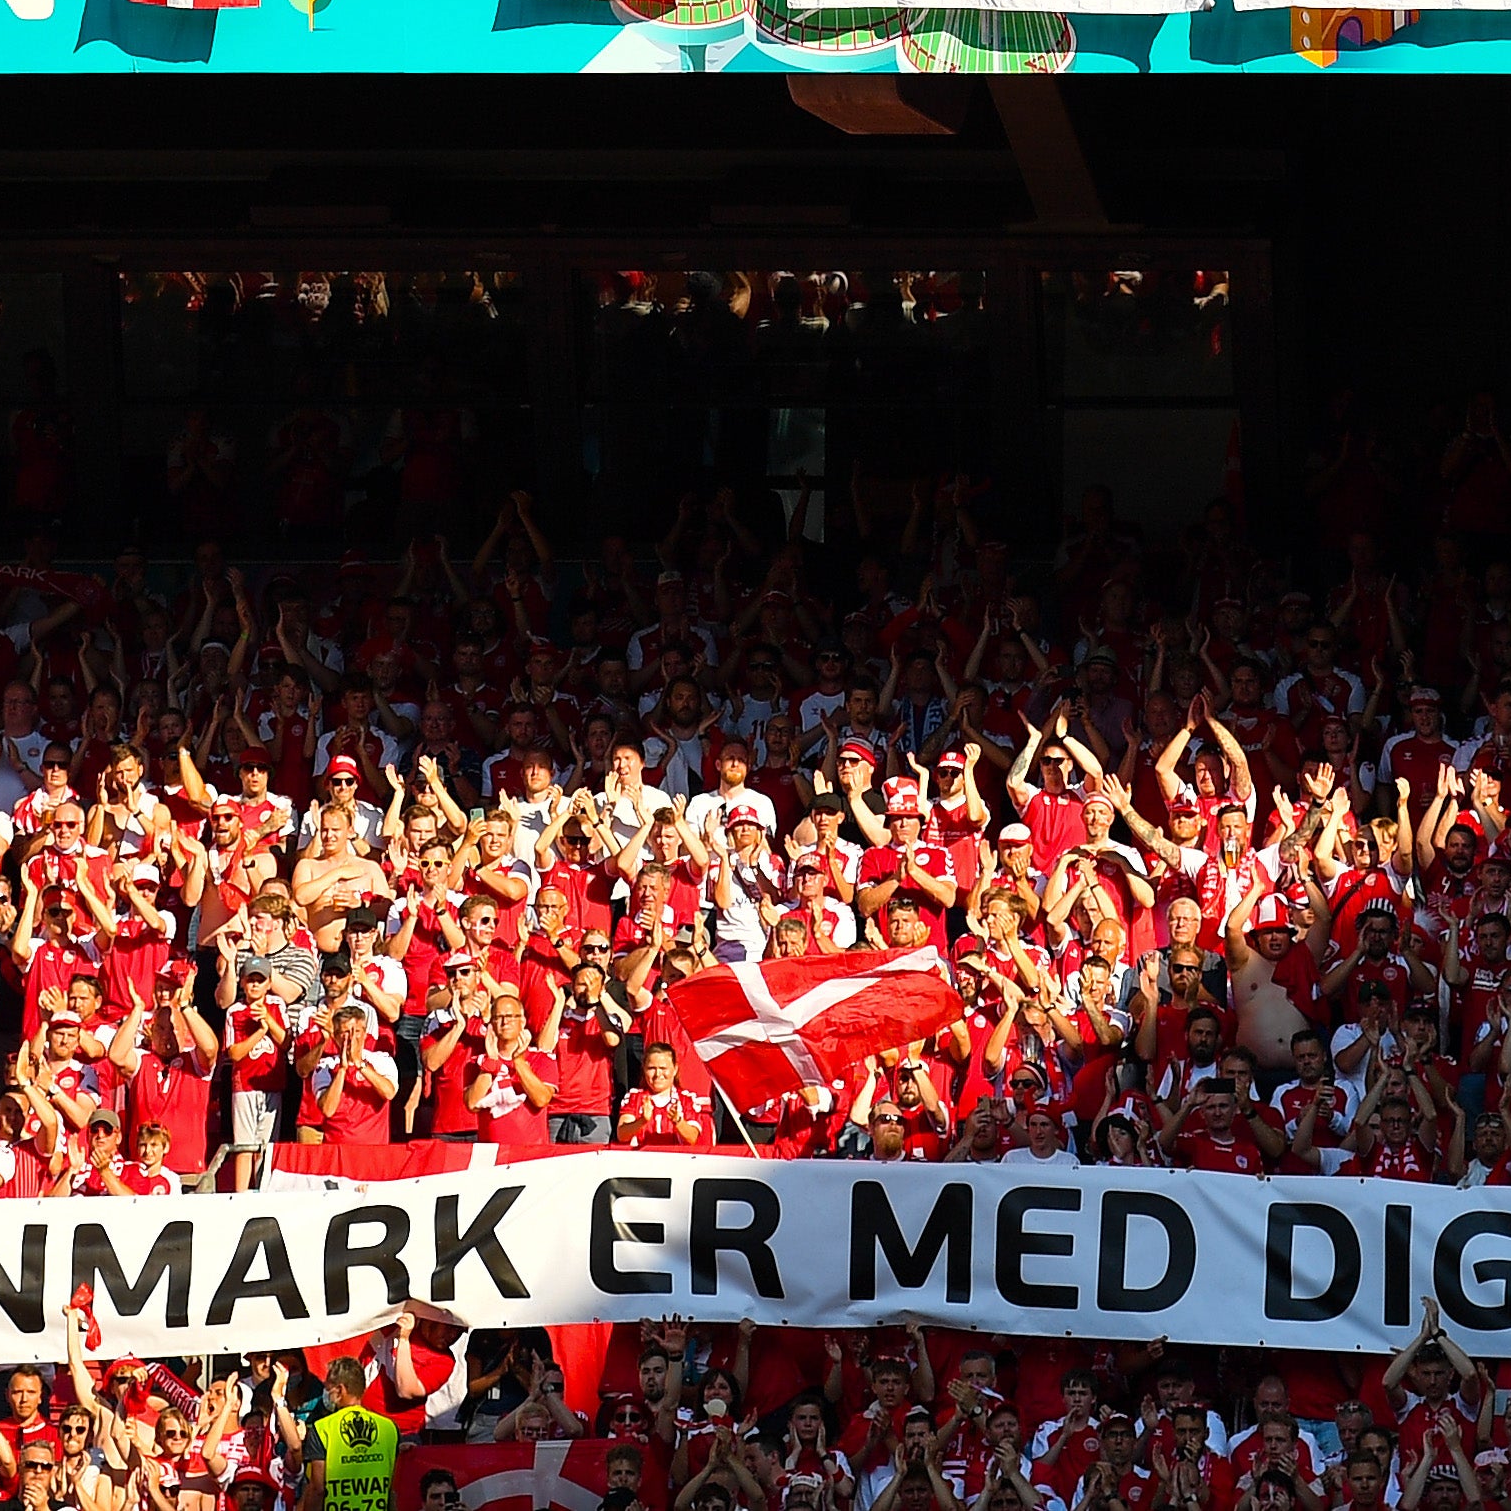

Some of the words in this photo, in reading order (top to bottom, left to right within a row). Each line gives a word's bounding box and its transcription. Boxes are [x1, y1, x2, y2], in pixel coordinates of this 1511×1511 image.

[589, 1178, 786, 1300] ER
[849, 1181, 1197, 1313] MED
[326, 1477, 391, 1496] TEWAR
